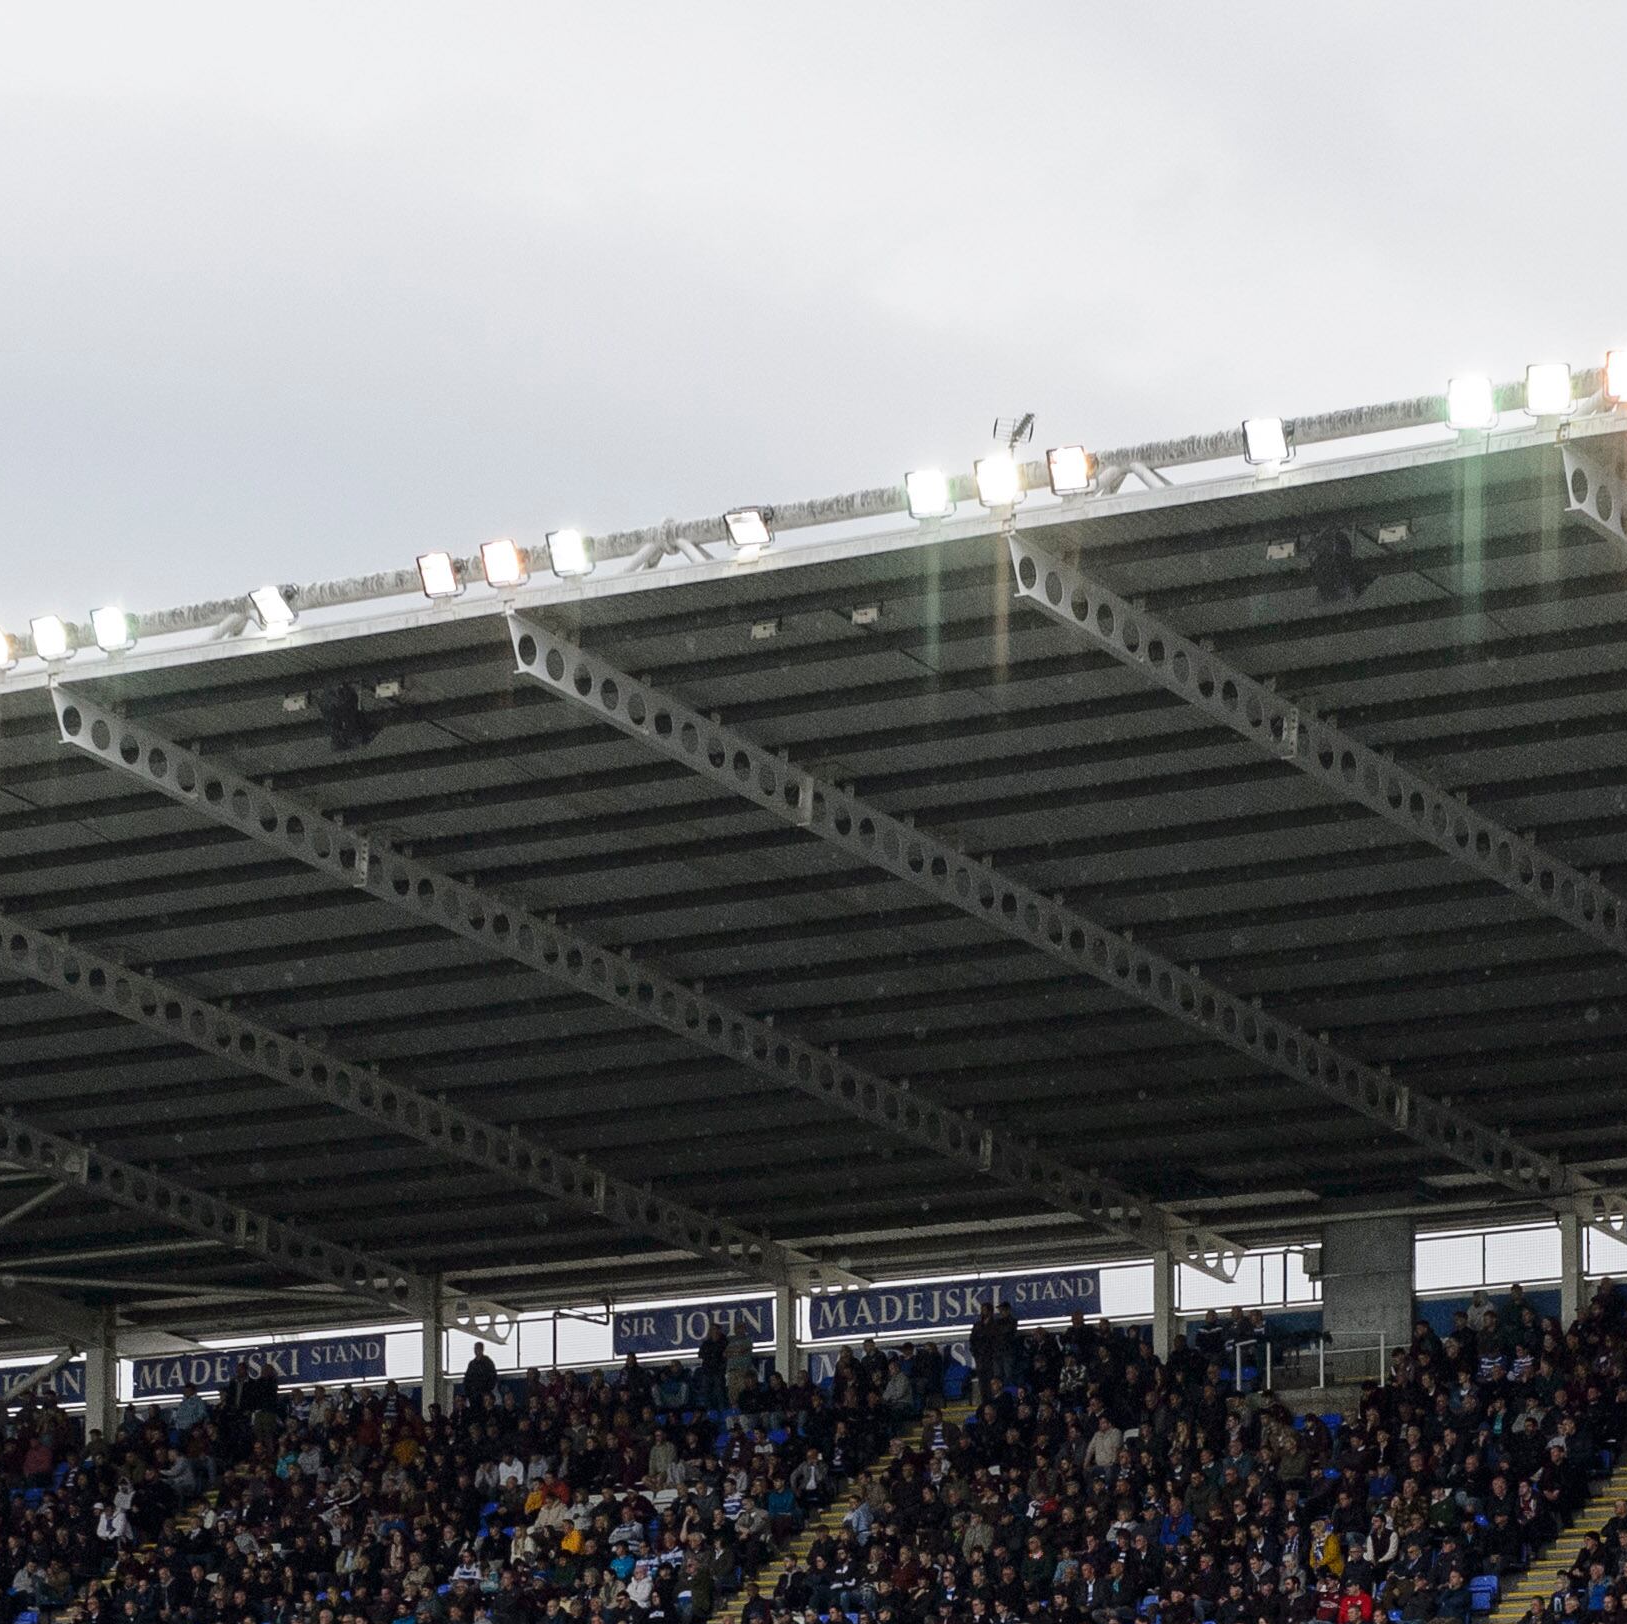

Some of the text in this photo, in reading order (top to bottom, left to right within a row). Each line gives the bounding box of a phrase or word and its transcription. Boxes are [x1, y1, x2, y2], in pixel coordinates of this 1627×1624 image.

[817, 1276, 1096, 1330] MADEJSKI STAND
[620, 1305, 763, 1345] SIR JOHN
[310, 1342, 381, 1365] STAND
